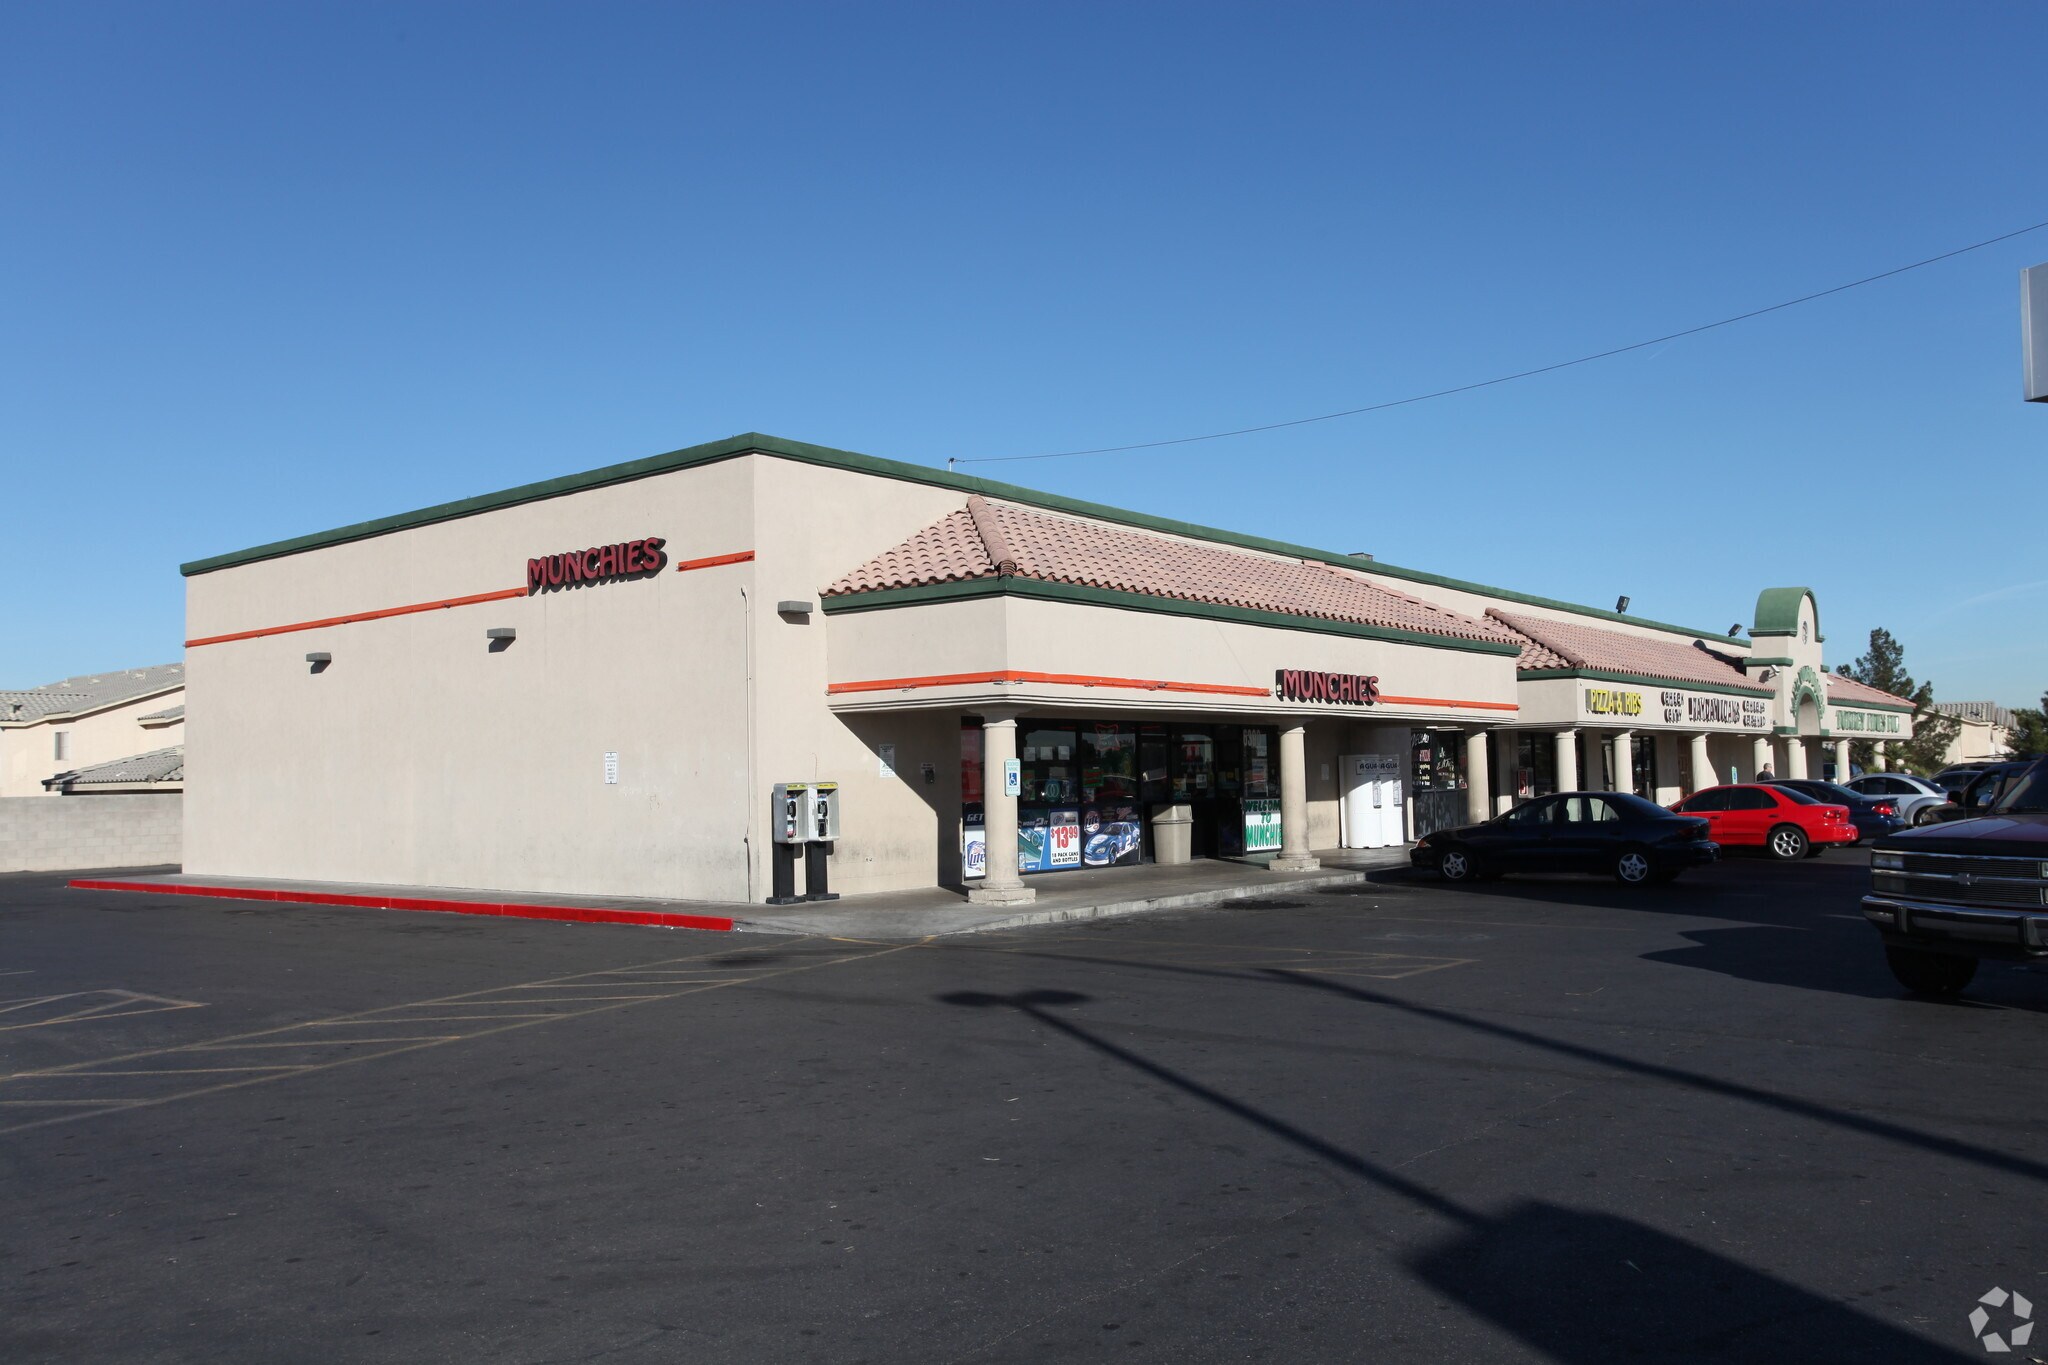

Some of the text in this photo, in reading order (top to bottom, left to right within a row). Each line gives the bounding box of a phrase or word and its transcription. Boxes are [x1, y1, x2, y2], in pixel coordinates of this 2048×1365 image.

[527, 537, 666, 594] MUNCHIES
[1277, 669, 1380, 703] MUNCHIES
[1587, 689, 1614, 713] PIZZA
[1625, 693, 1641, 714] RIBS
[967, 814, 984, 822] GET
[1261, 811, 1271, 823] TO
